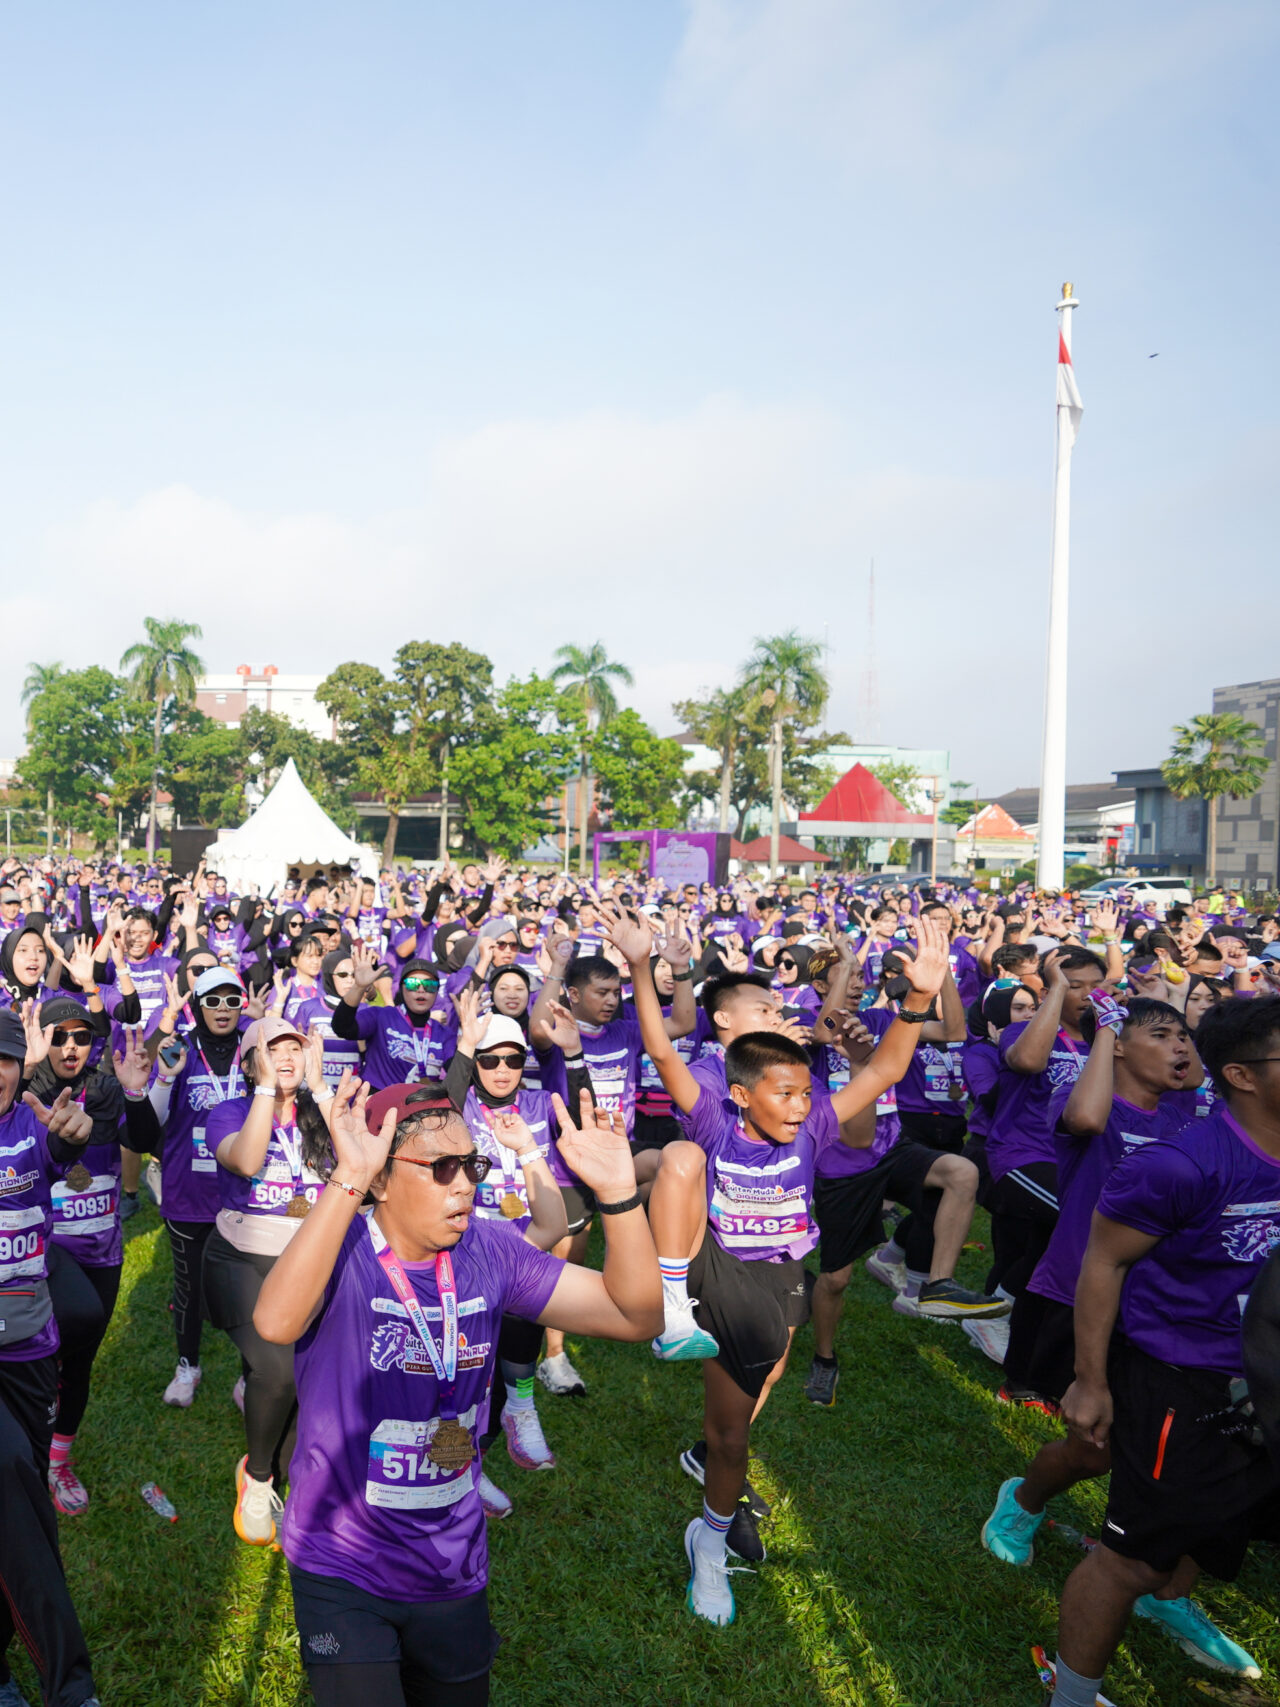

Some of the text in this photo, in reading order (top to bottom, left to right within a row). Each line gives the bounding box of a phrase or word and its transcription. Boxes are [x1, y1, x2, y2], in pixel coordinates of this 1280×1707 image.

[596, 1096, 620, 1112] 122
[22, 1171, 38, 1182] RUN
[255, 1183, 318, 1205] 5090
[726, 1184, 775, 1195] Sultan Muda
[788, 1186, 805, 1196] RUN
[62, 1193, 110, 1219] 50931
[719, 1216, 797, 1234] 51492
[413, 1310, 424, 1327] BNI
[472, 1344, 490, 1356] RUN
[382, 1450, 455, 1480] 514
